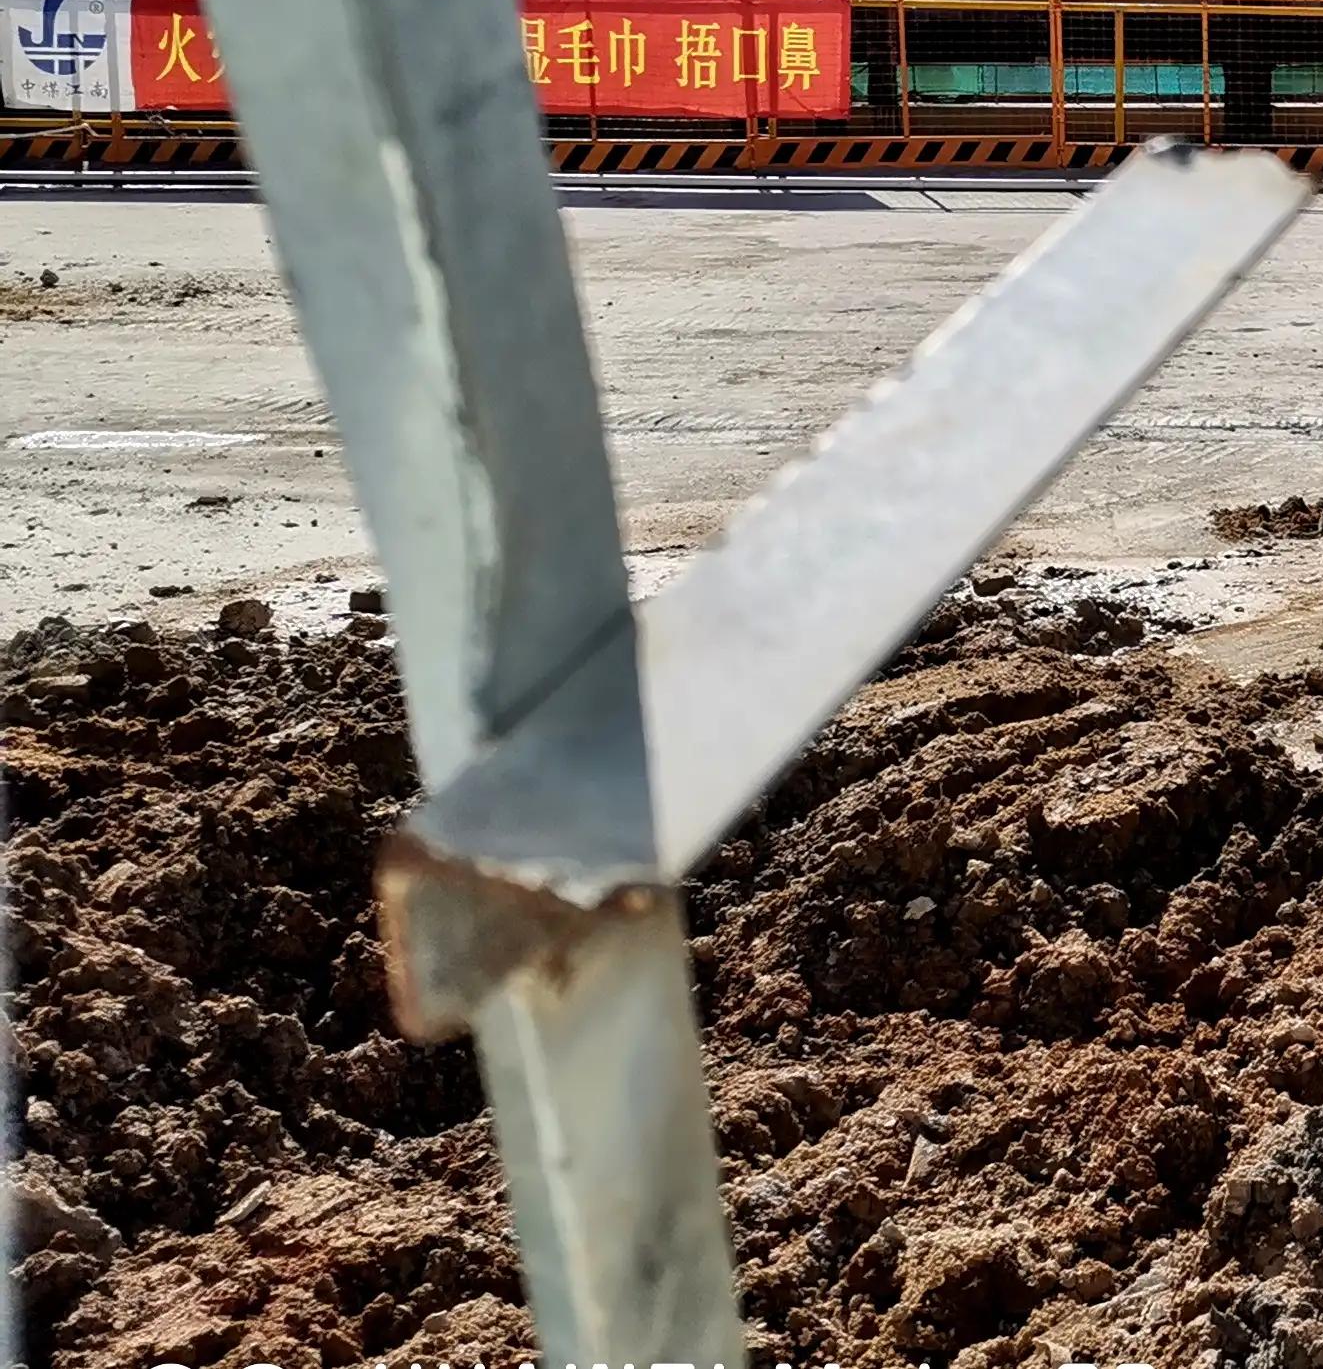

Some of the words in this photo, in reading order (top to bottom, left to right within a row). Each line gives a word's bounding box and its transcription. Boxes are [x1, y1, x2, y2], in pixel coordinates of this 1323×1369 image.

[673, 18, 821, 91] 捂口鼻
[21, 79, 109, 99] 中煤江南
